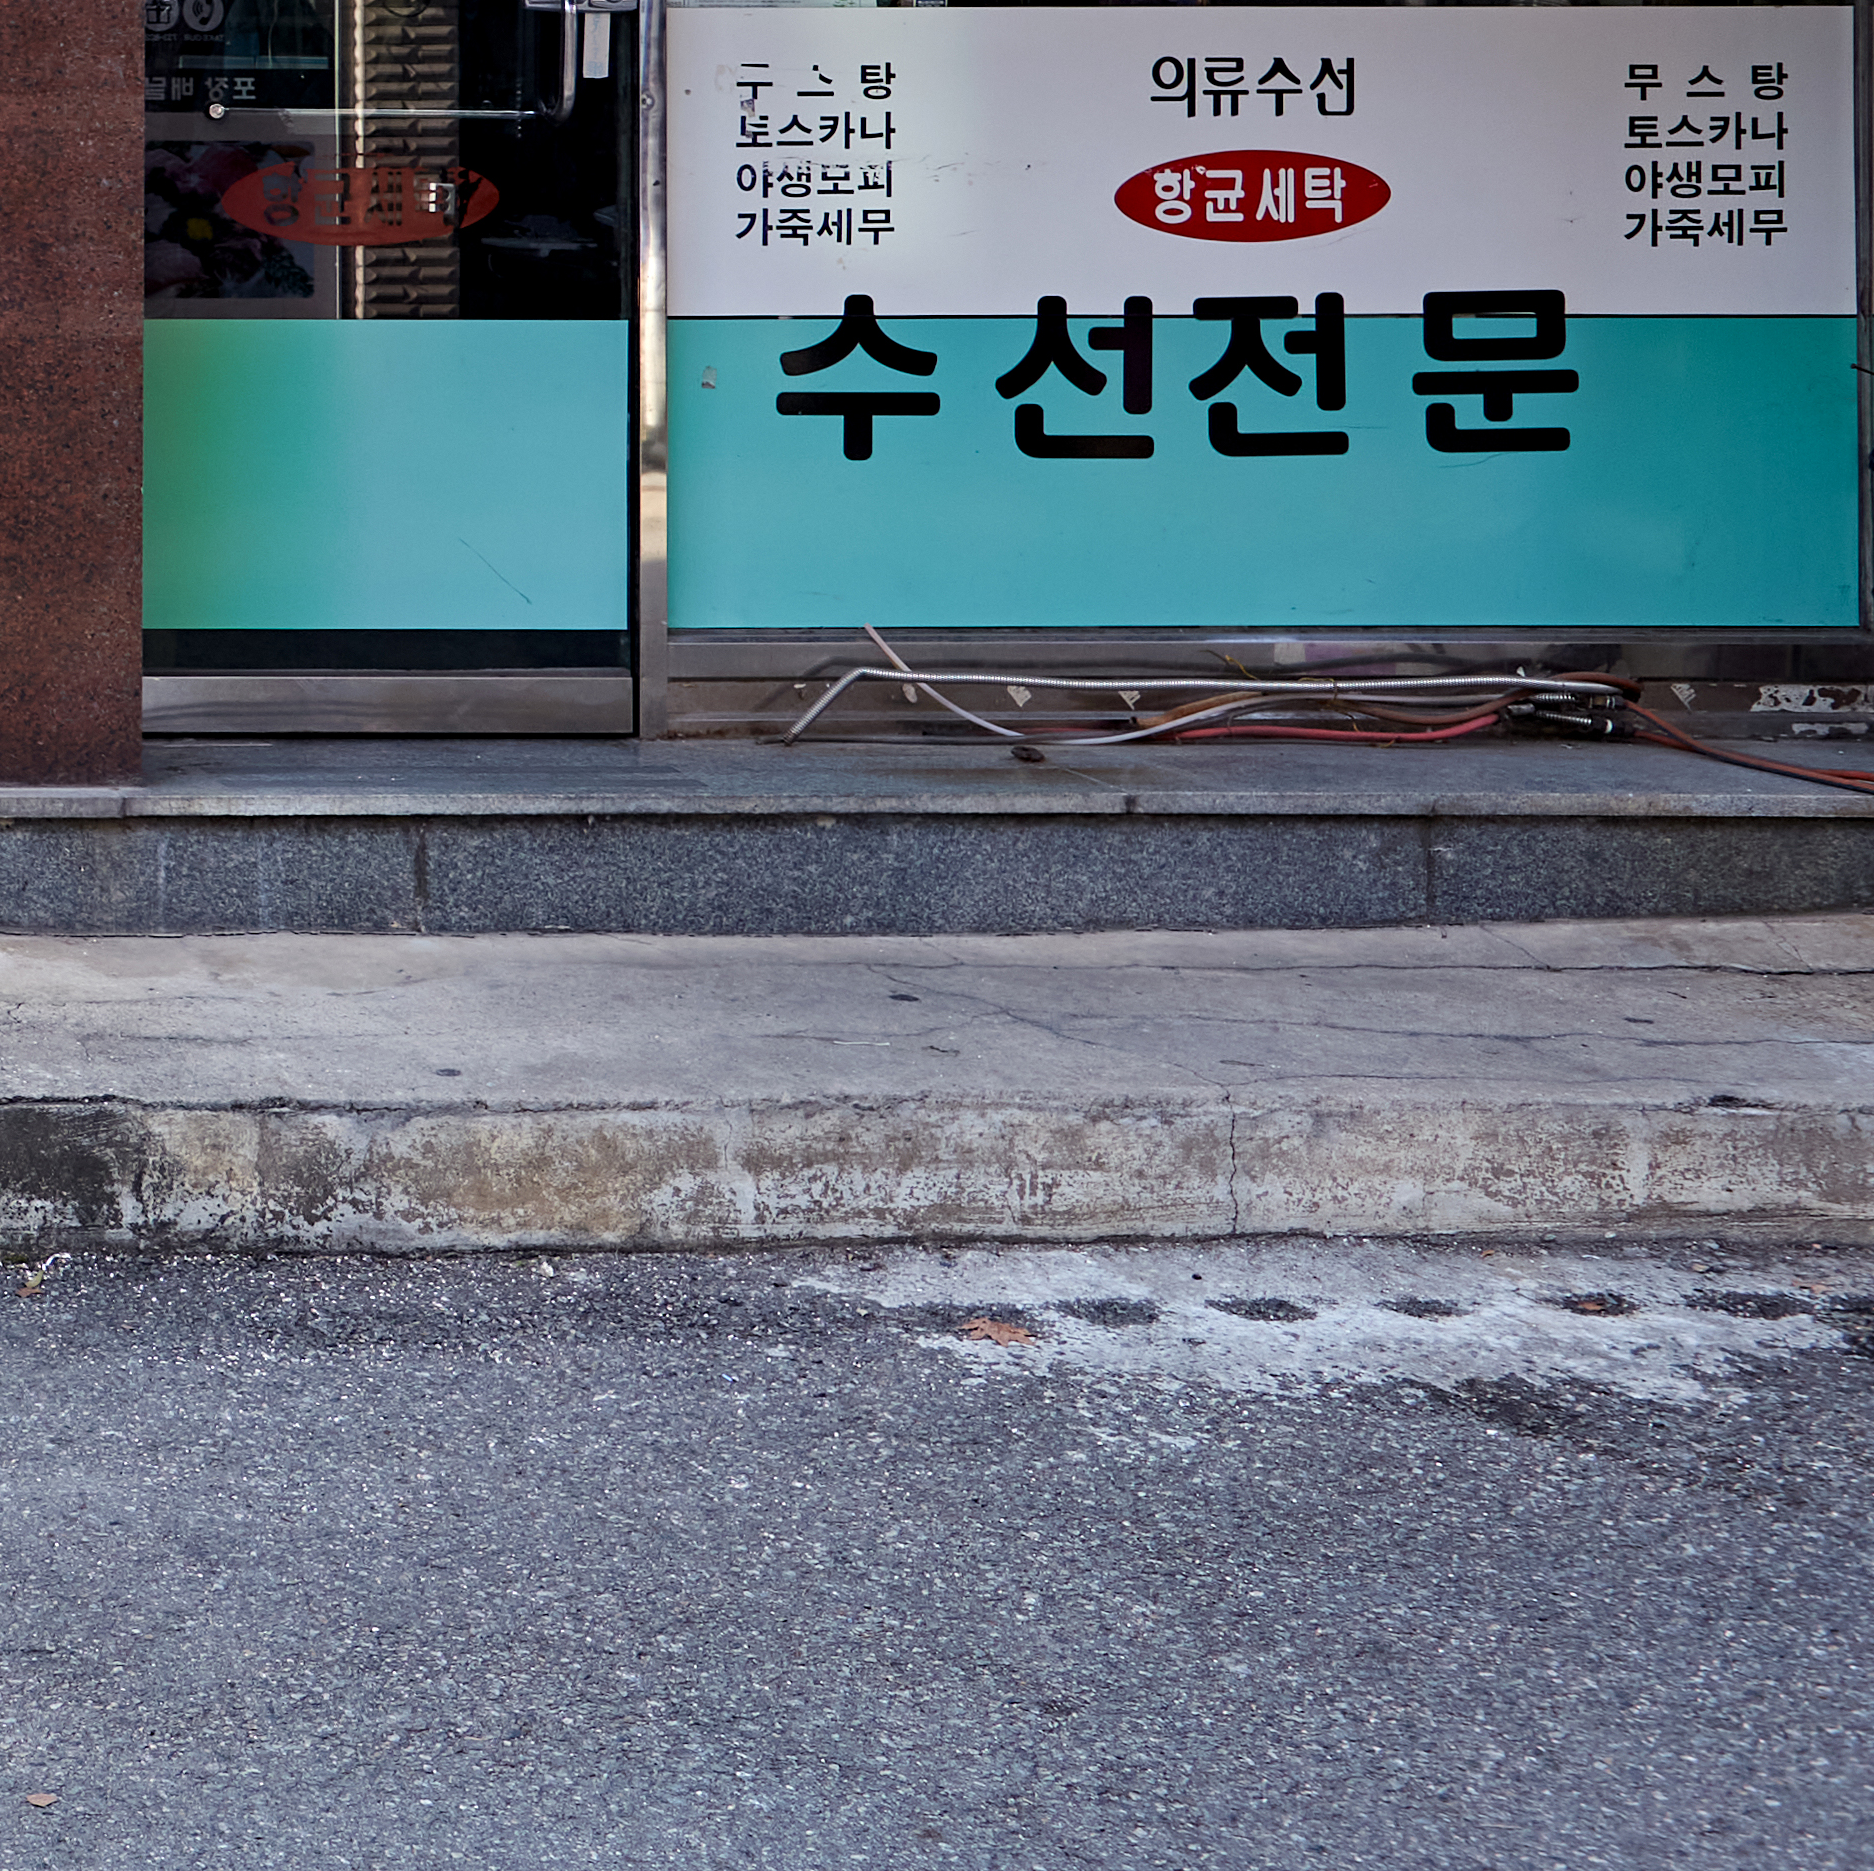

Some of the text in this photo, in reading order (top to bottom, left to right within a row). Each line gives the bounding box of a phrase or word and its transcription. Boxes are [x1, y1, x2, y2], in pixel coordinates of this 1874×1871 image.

[1150, 56, 1355, 118] 의류수선
[1626, 110, 1789, 151] 토스카나
[1153, 165, 1347, 224] 항균세탁
[1625, 158, 1787, 199] 야생모피
[735, 206, 896, 247] 가죽세무
[1624, 206, 1789, 248] 가죽세무
